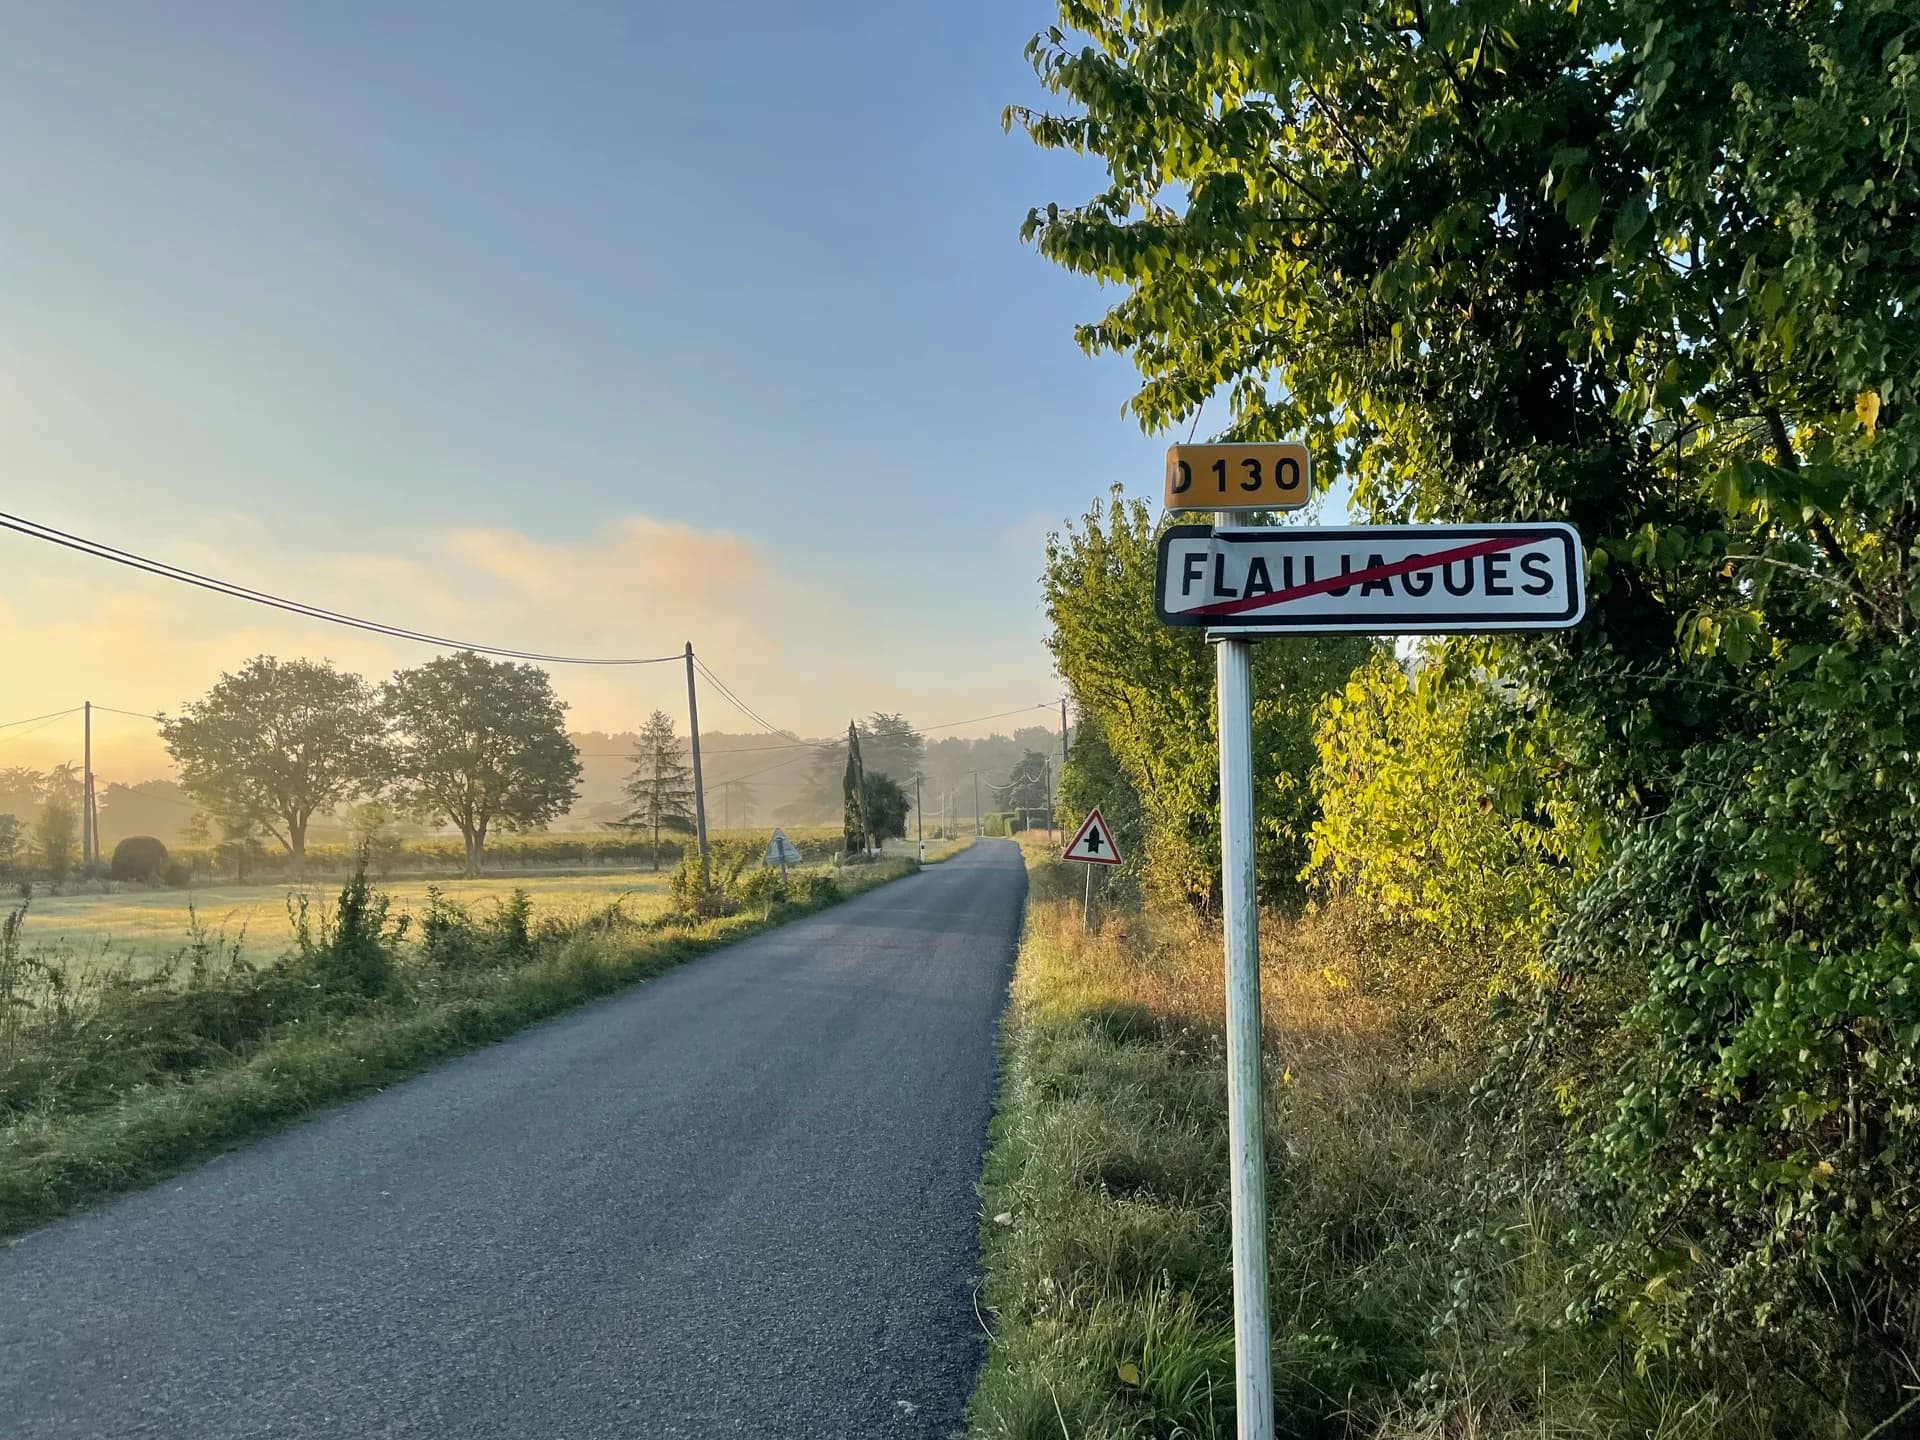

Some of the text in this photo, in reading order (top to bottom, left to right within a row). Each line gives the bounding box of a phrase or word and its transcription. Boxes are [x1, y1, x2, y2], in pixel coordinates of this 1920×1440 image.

[1170, 457, 1300, 494] D 130
[1181, 551, 1555, 598] FLAUJAGUES
